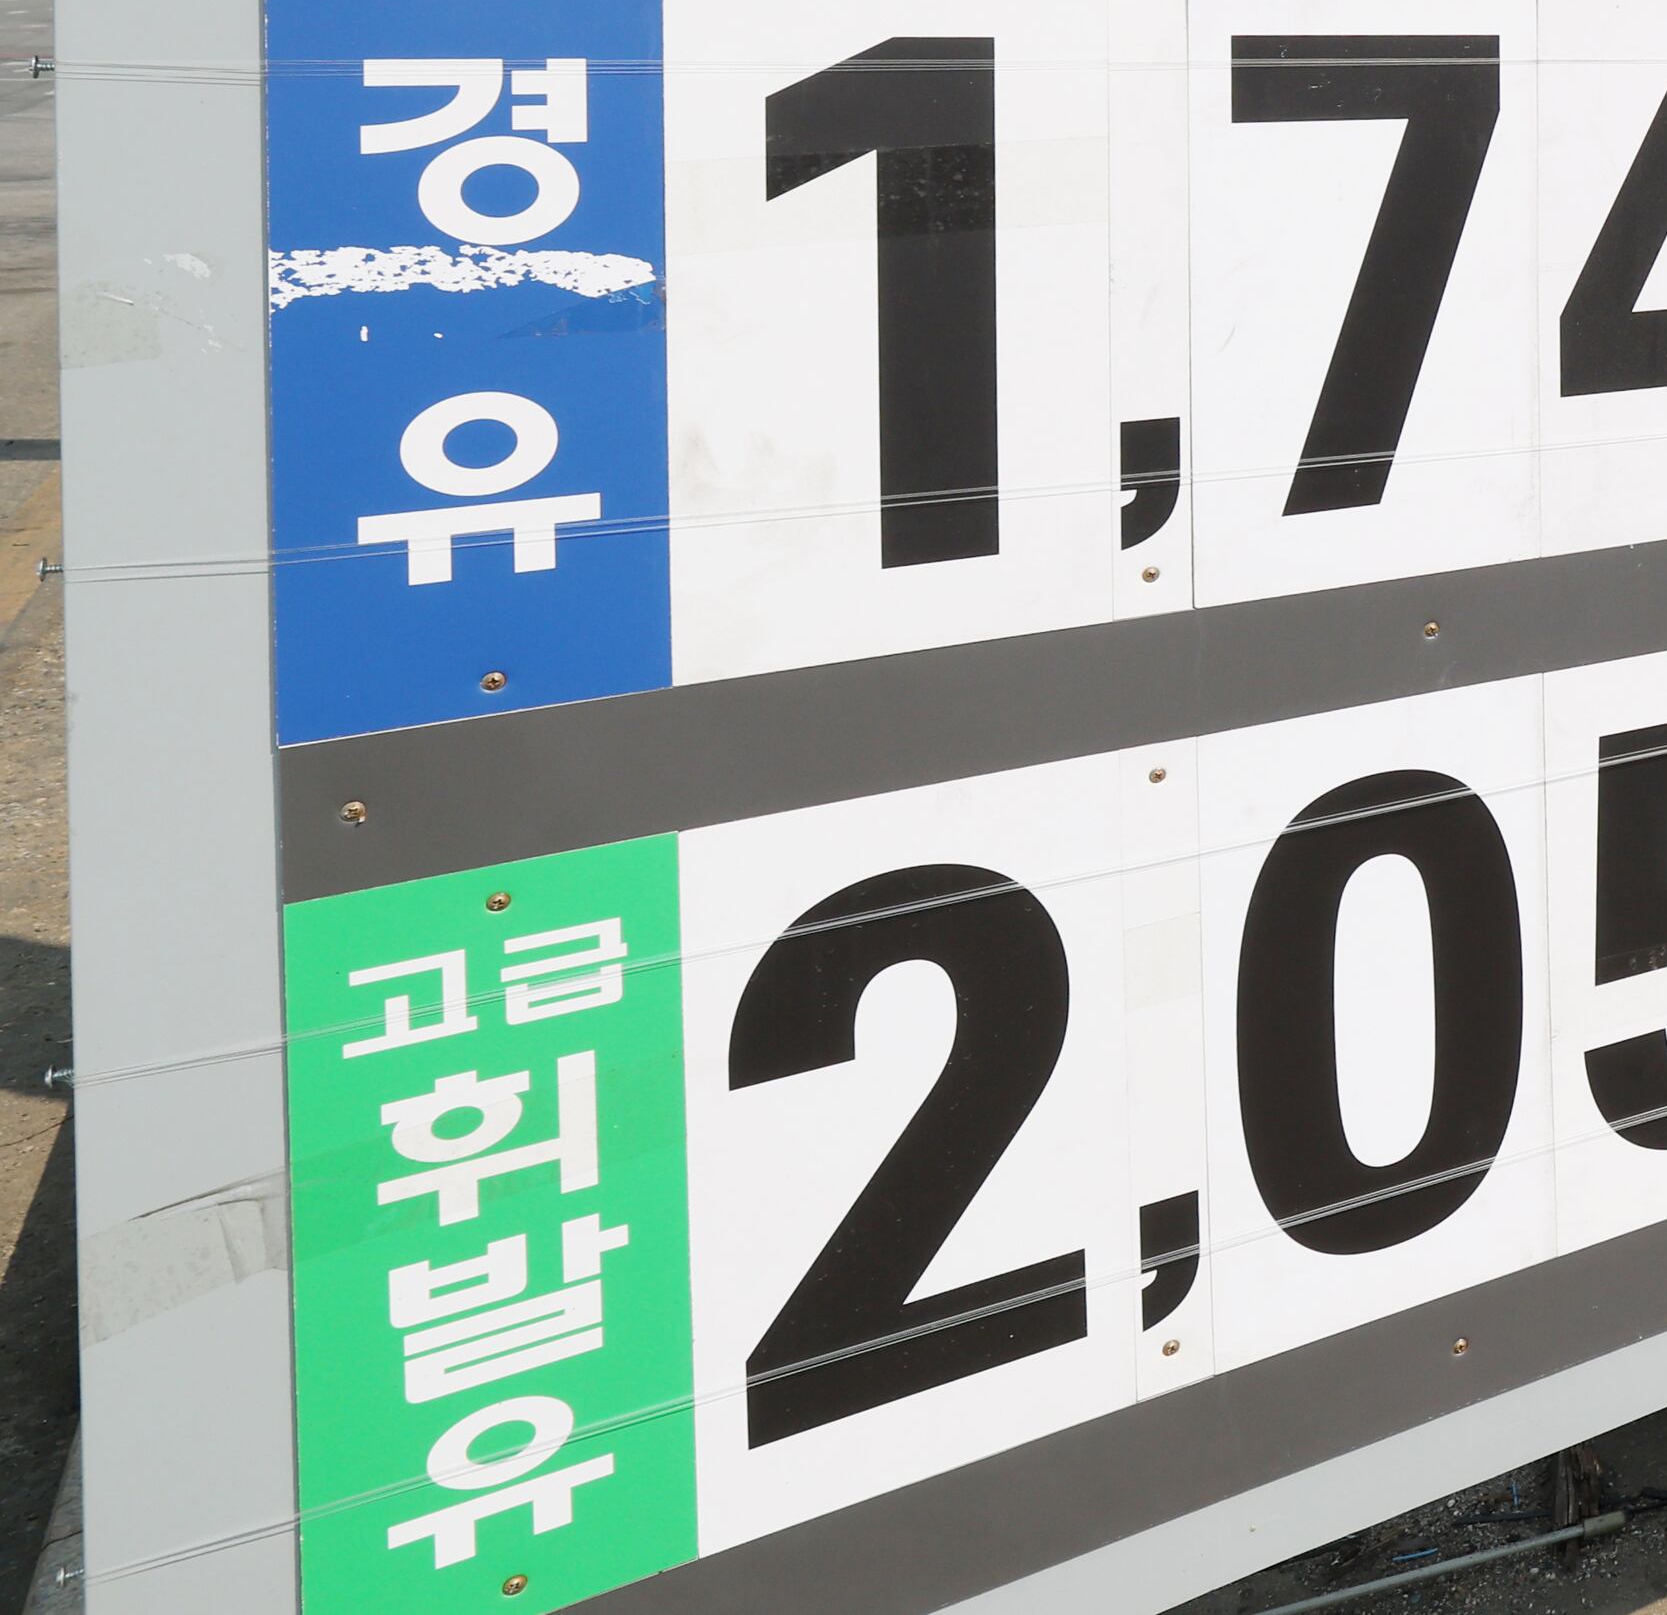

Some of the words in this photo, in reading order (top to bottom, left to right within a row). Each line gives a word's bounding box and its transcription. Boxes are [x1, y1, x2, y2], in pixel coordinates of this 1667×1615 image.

[357, 58, 600, 586] 경유
[341, 917, 629, 1060] 고급
[377, 1050, 629, 1570] 휘발유
